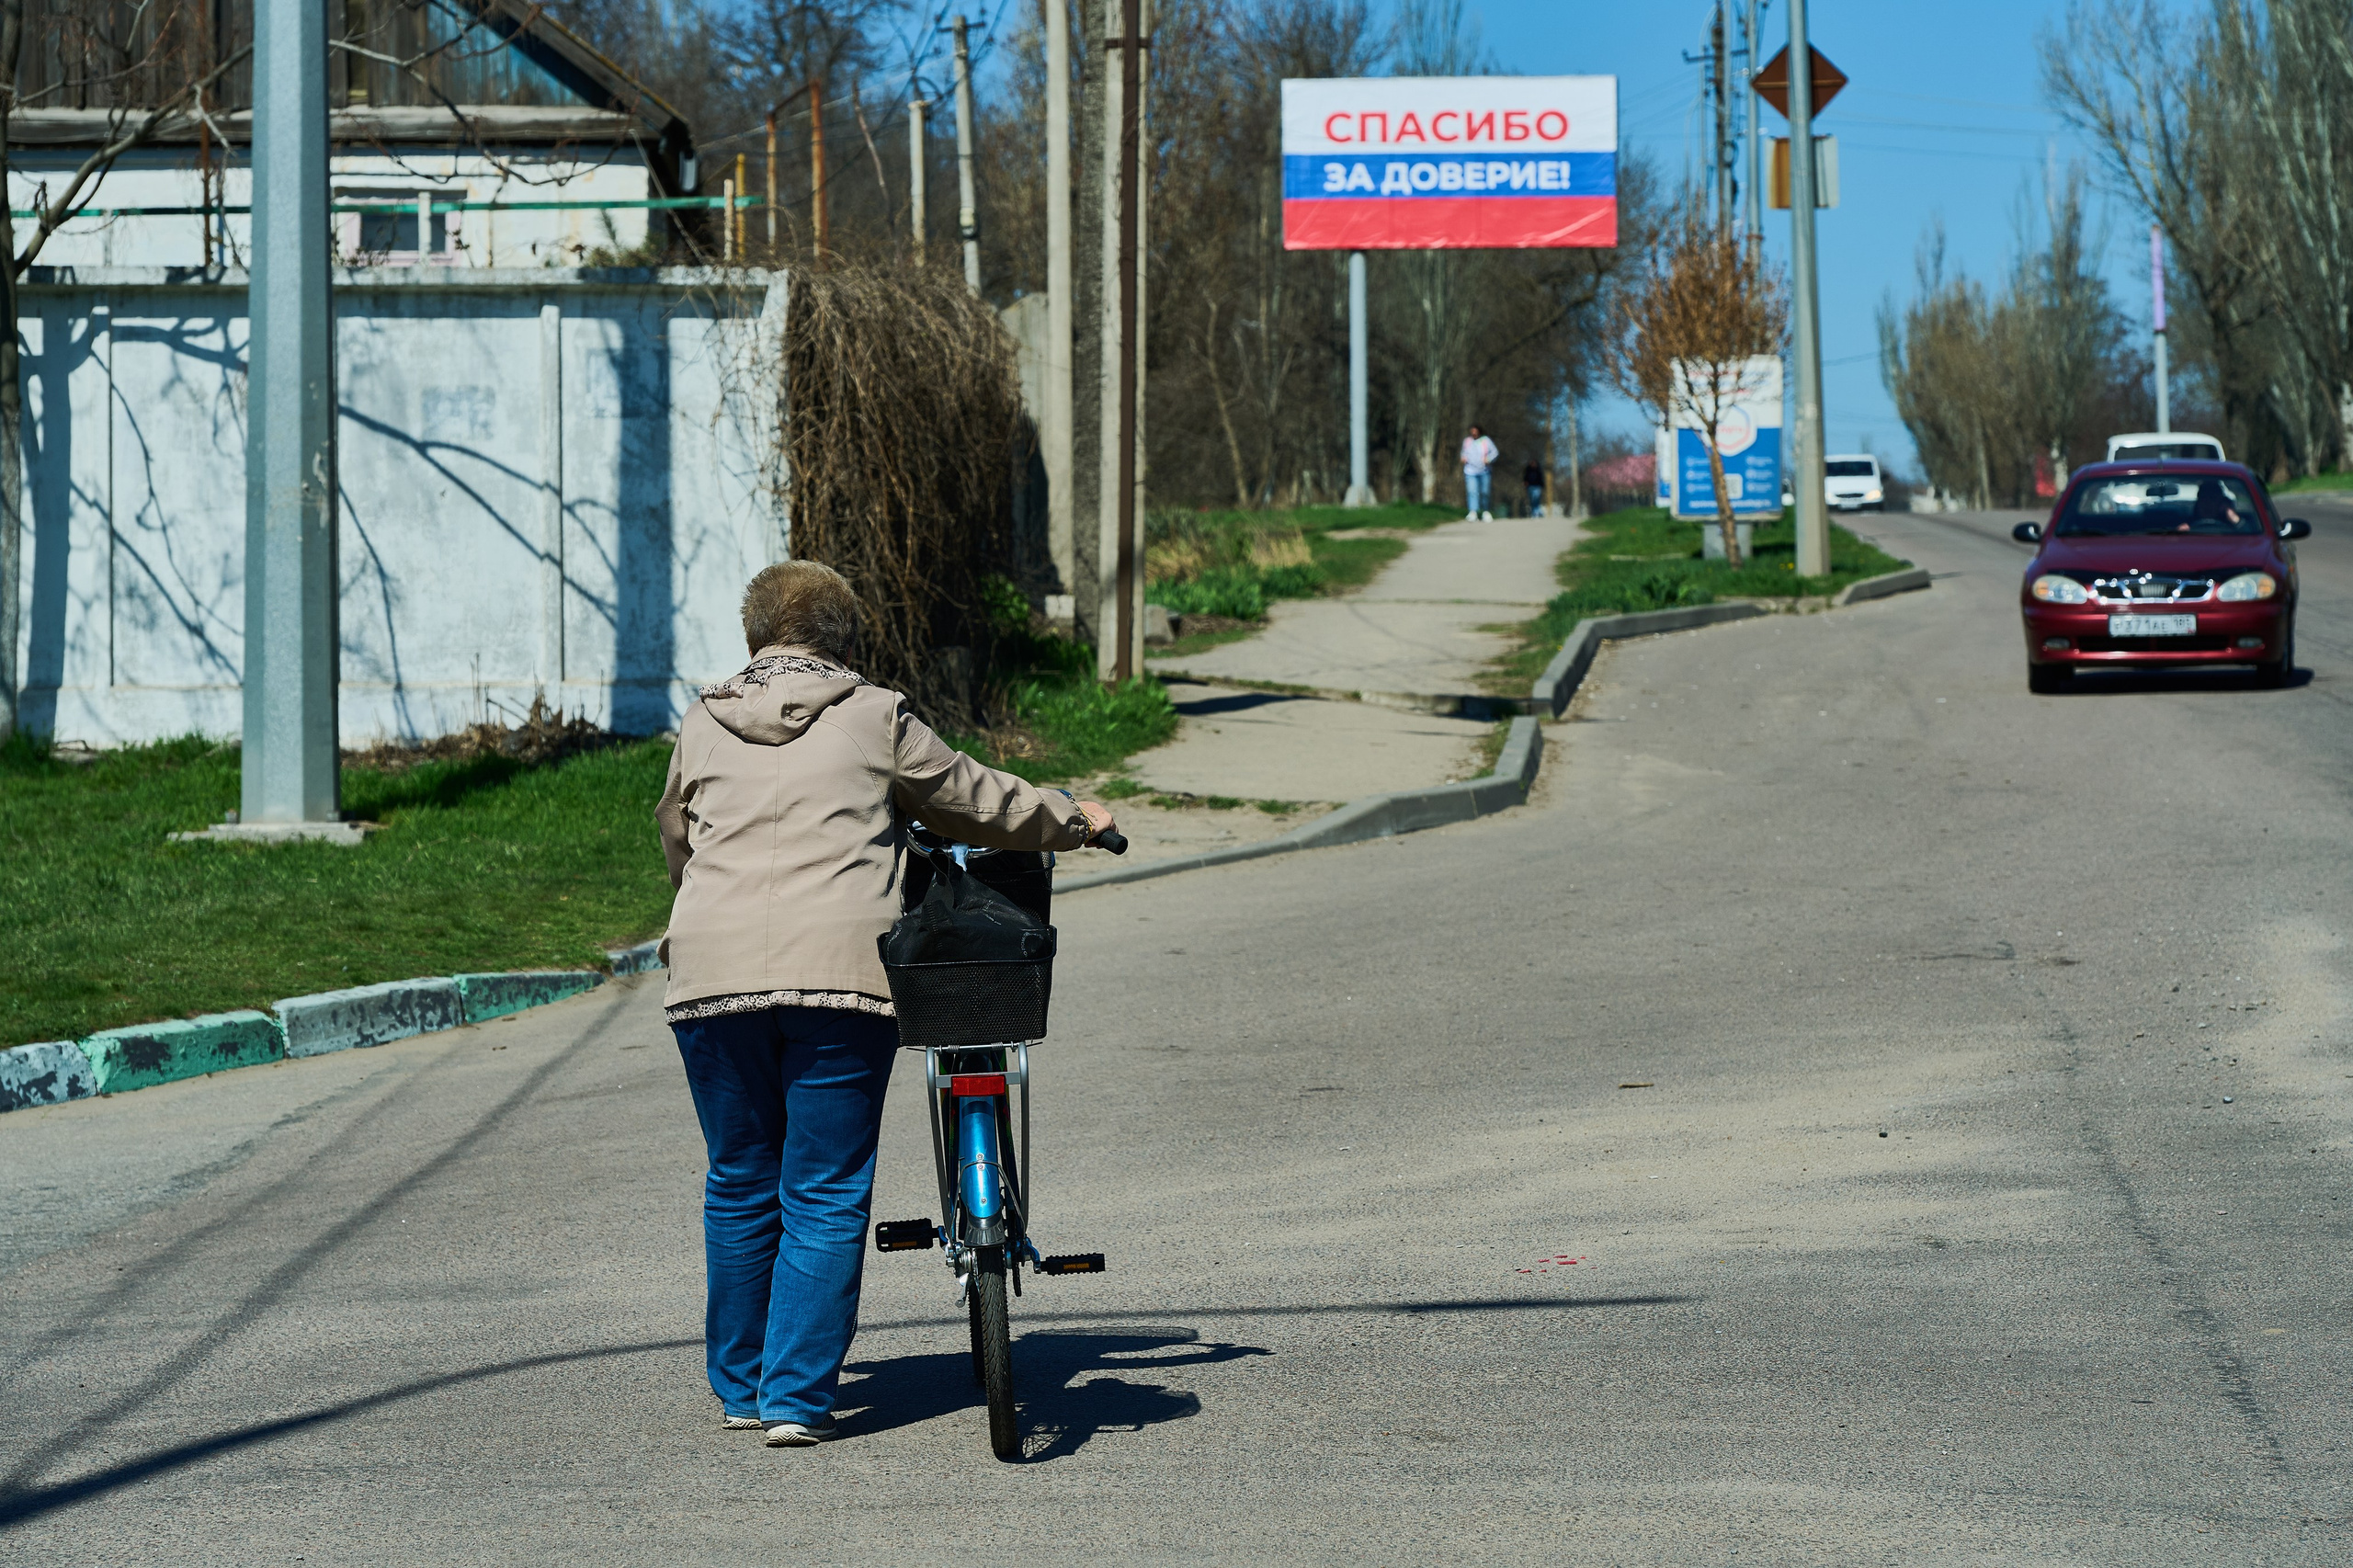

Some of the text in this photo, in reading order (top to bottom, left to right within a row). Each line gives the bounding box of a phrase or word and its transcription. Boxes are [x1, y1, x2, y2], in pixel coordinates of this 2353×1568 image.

[1324, 109, 1569, 143] СПАСИБО
[1323, 161, 1571, 197] ЗА ДОВЕРИЕ!
